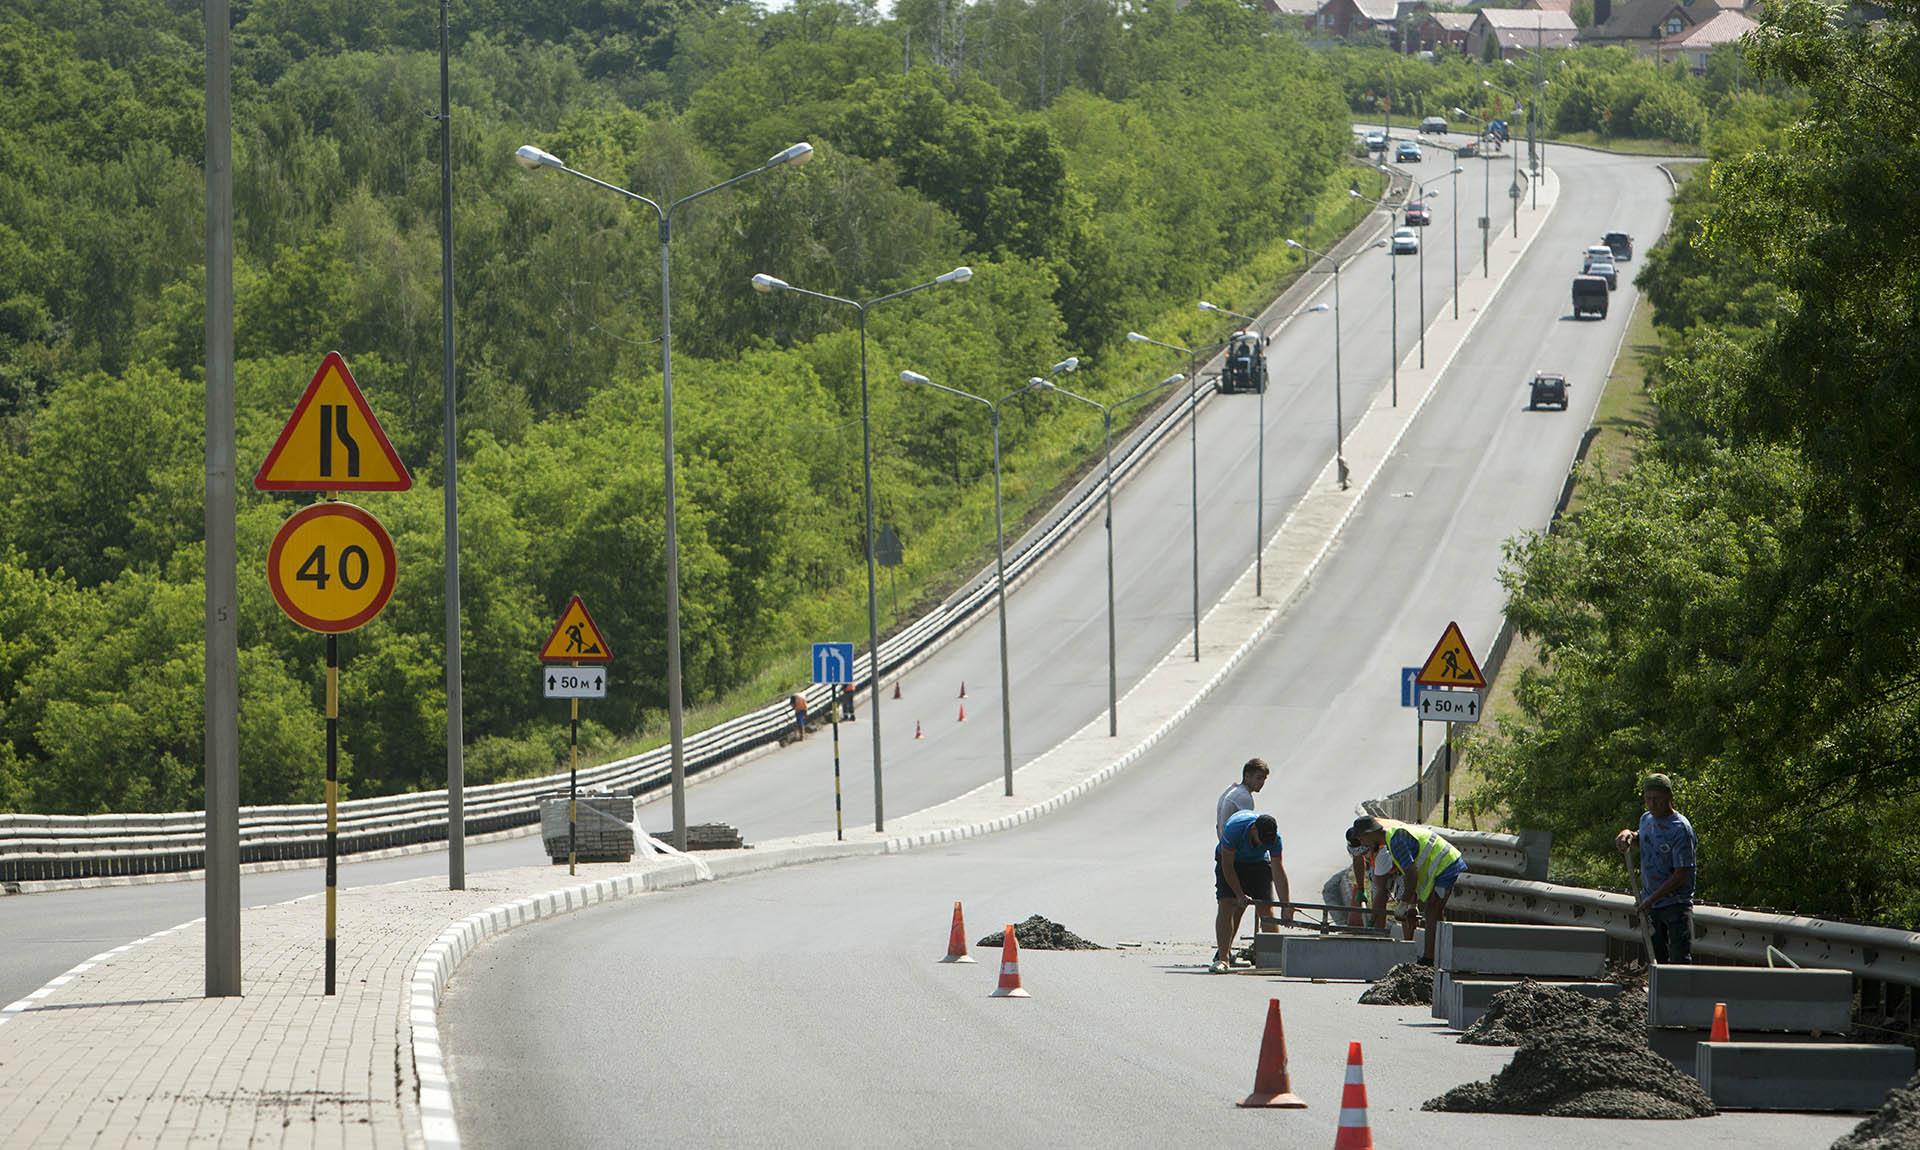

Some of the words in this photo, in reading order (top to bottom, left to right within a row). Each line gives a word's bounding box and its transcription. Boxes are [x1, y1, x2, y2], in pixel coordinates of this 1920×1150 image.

[296, 545, 369, 590] 40
[561, 676, 578, 689] 50
[1435, 700, 1452, 712] 50
